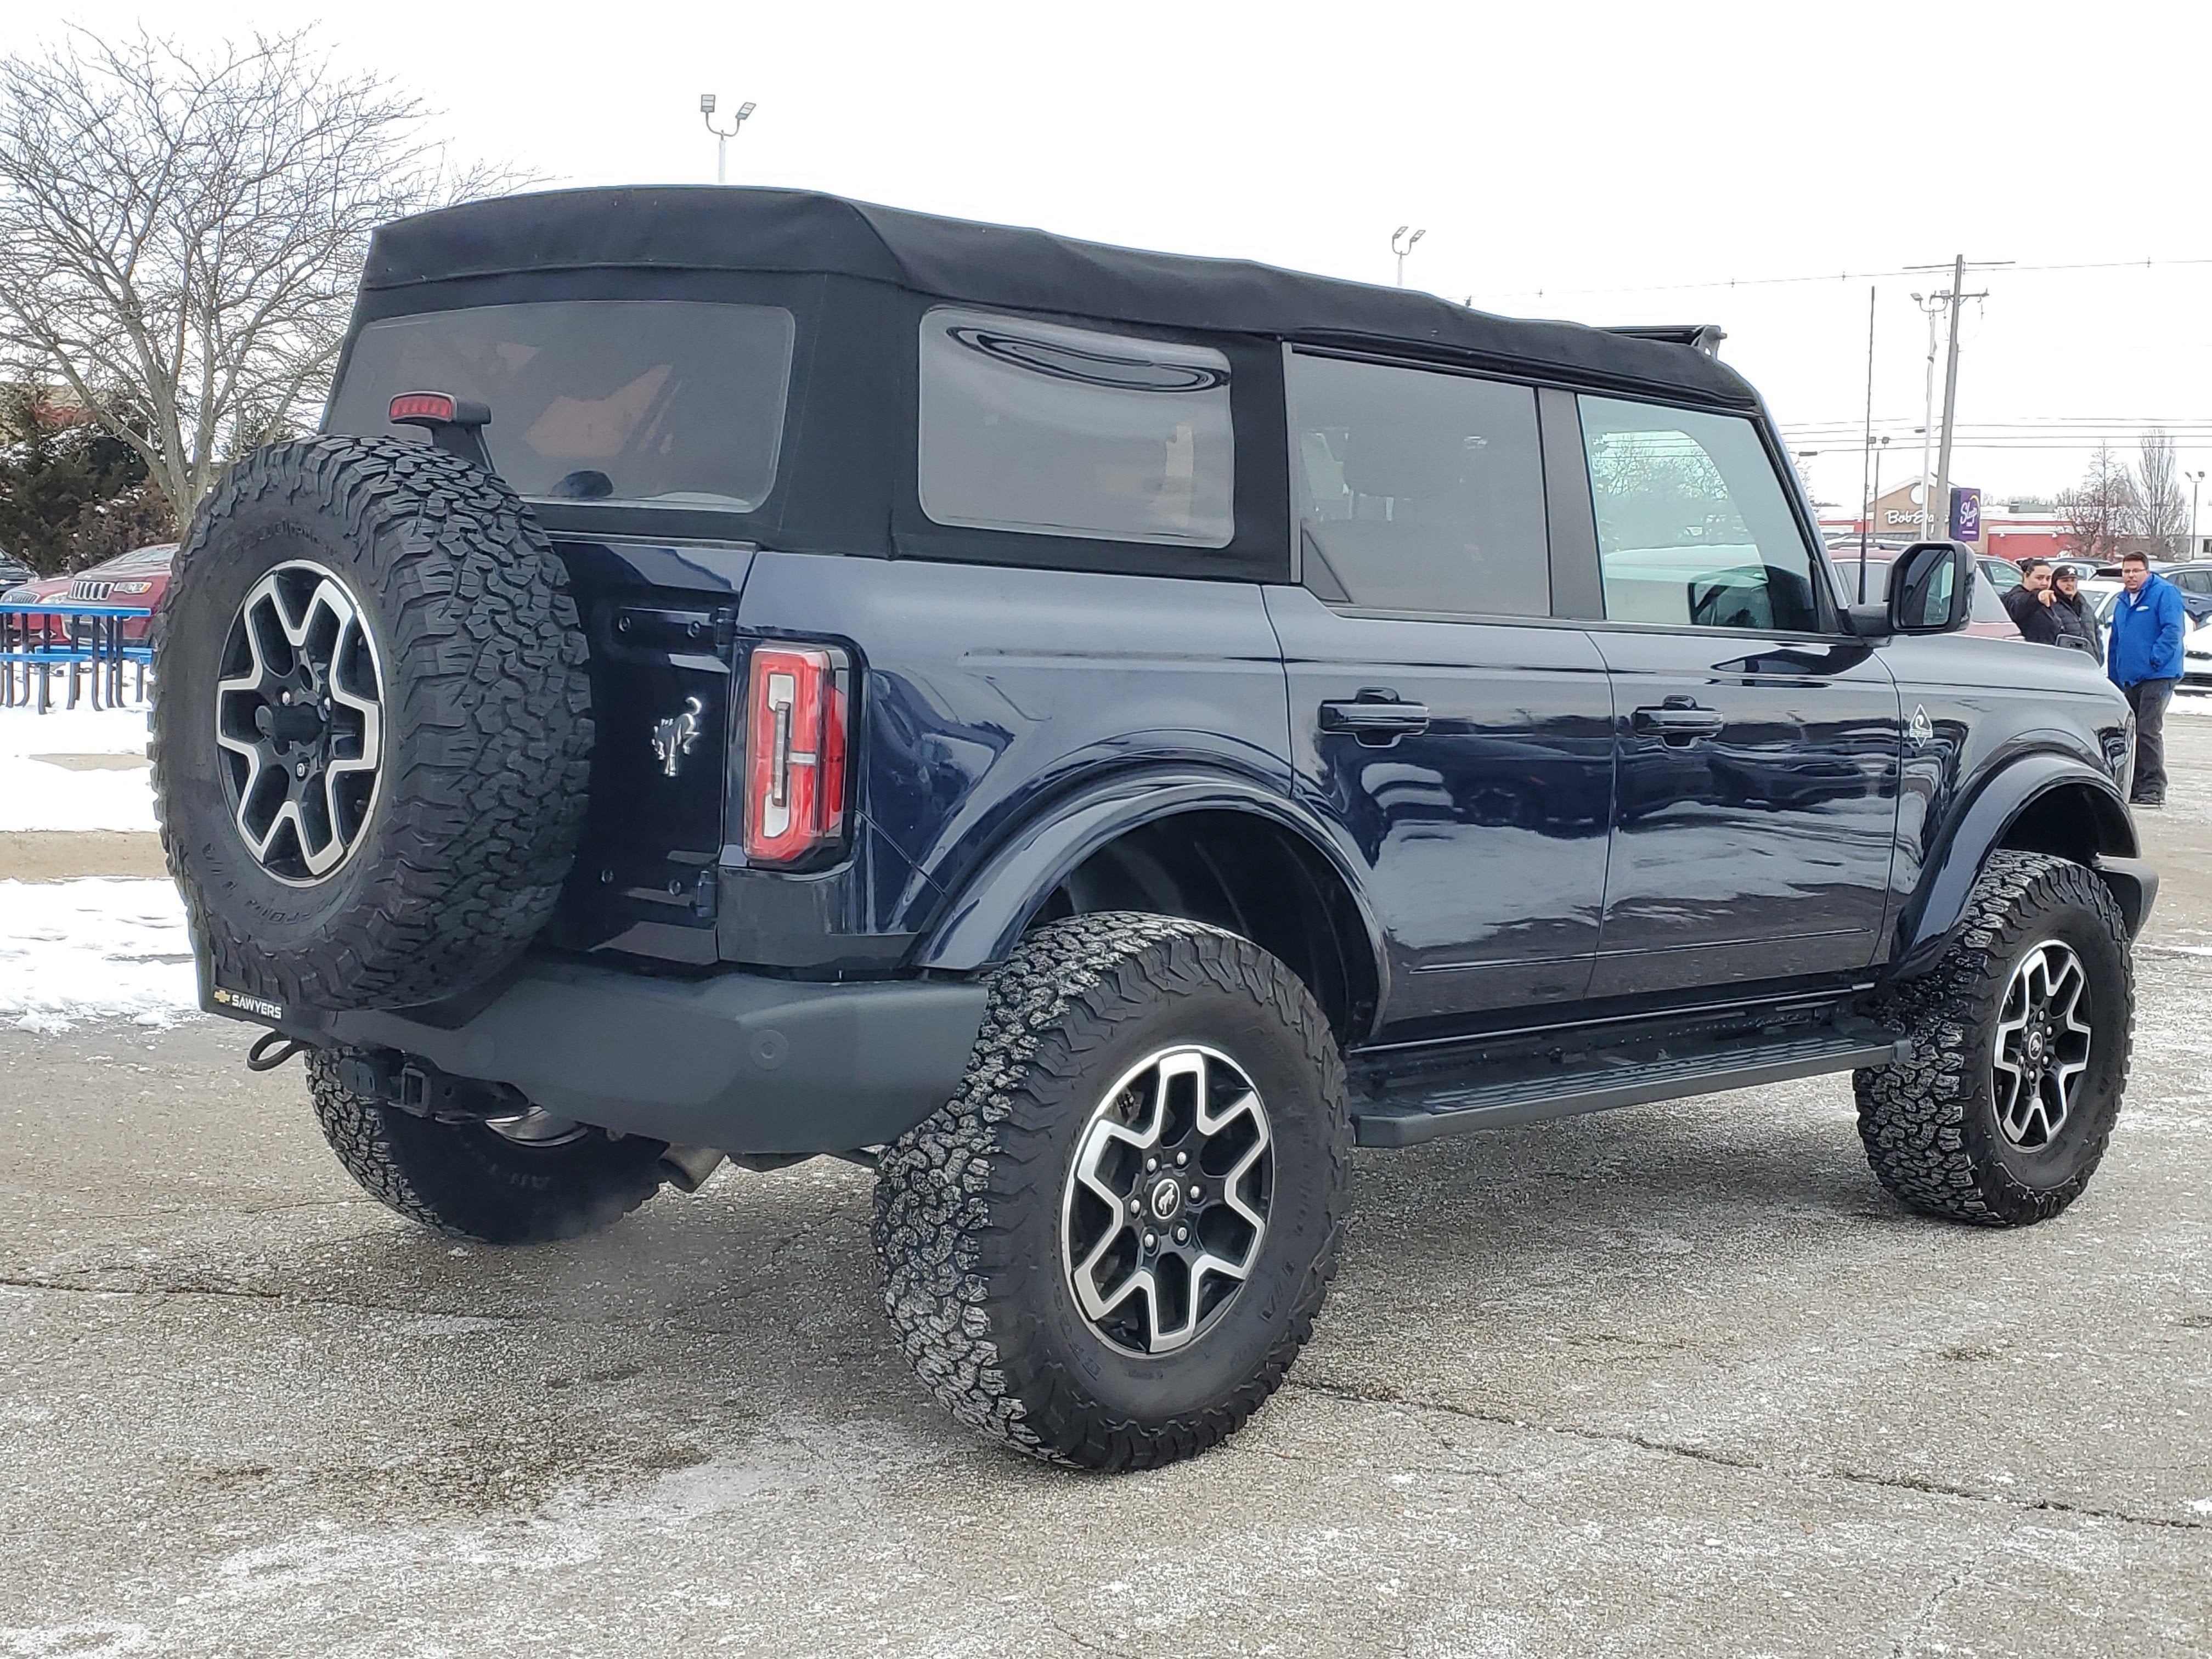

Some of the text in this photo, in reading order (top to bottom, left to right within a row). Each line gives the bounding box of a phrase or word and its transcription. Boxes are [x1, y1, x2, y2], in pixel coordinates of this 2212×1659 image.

[1884, 510, 1950, 524] Bob Eas
[232, 994, 281, 1019] SAWYERS
